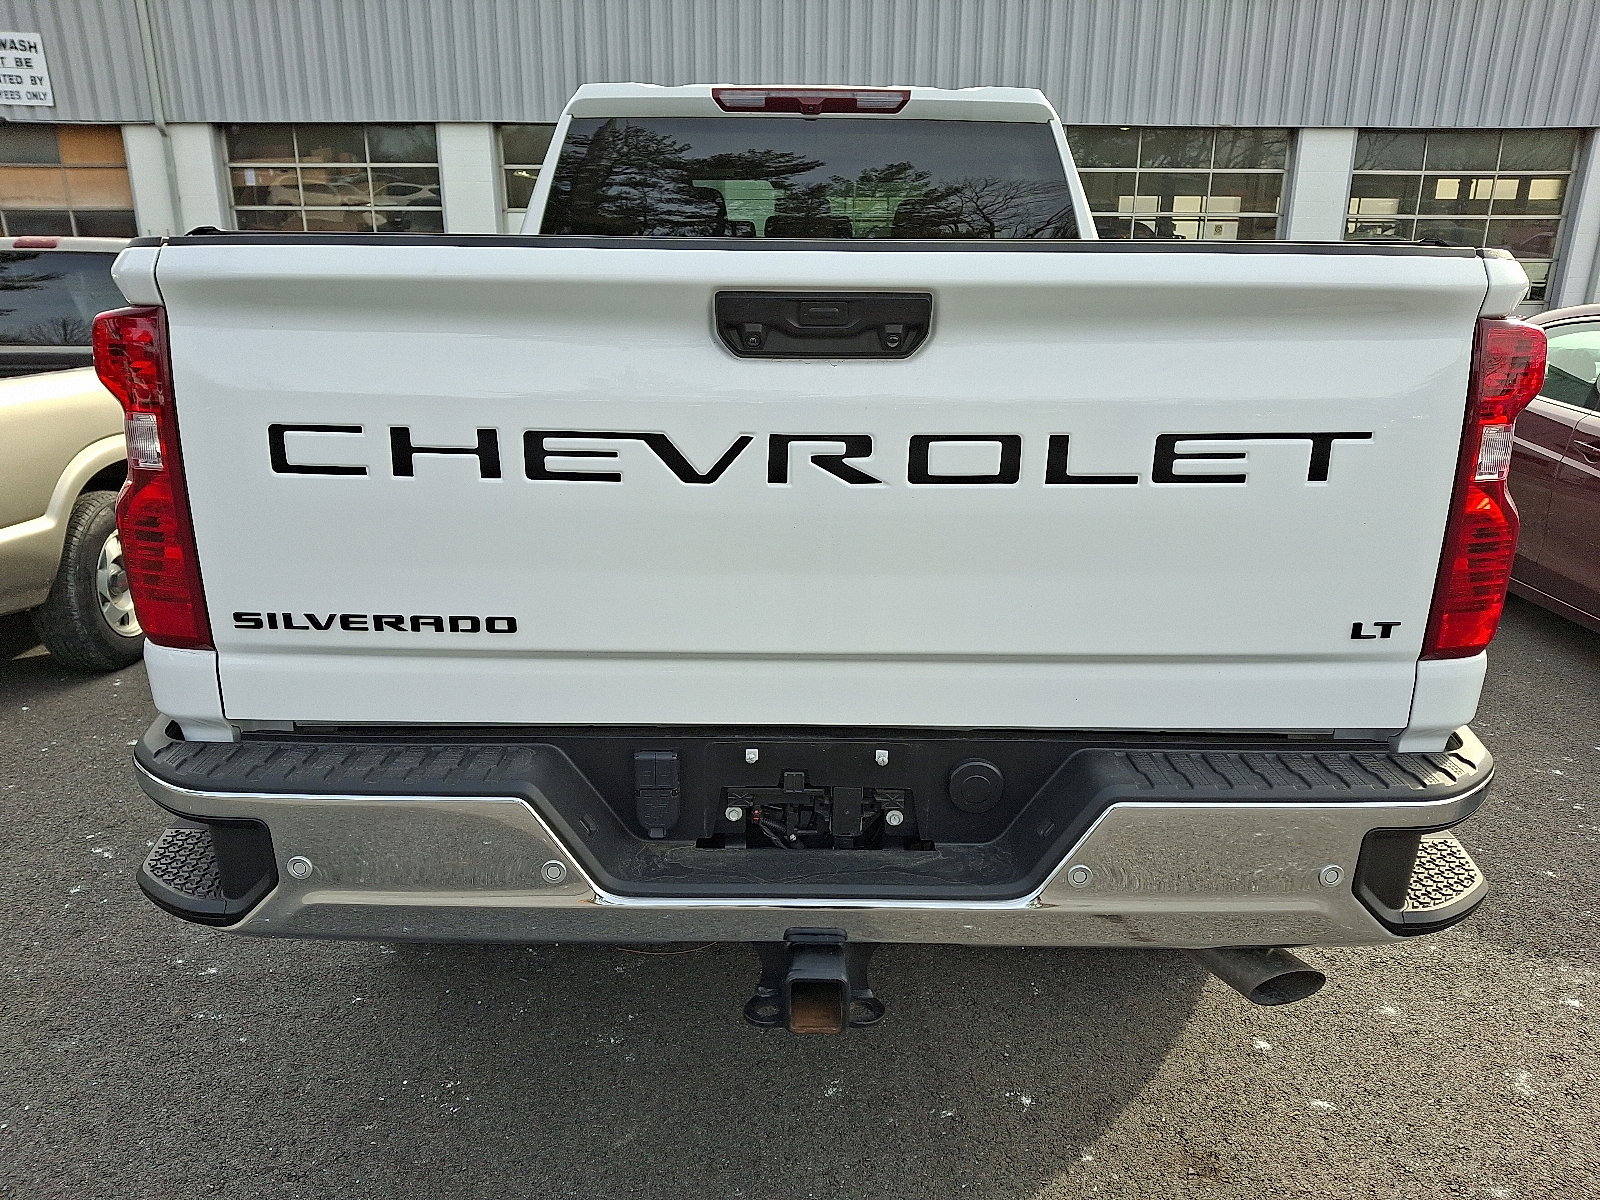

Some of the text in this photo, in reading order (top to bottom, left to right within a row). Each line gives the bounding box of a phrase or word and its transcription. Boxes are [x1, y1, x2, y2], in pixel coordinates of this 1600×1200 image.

[15, 57, 33, 68] BE
[0, 74, 43, 86] TED BY
[26, 91, 47, 101] ONLY
[268, 423, 1373, 485] CHEVROLET
[232, 611, 519, 634] SILVERADO
[1350, 621, 1402, 640] LT
